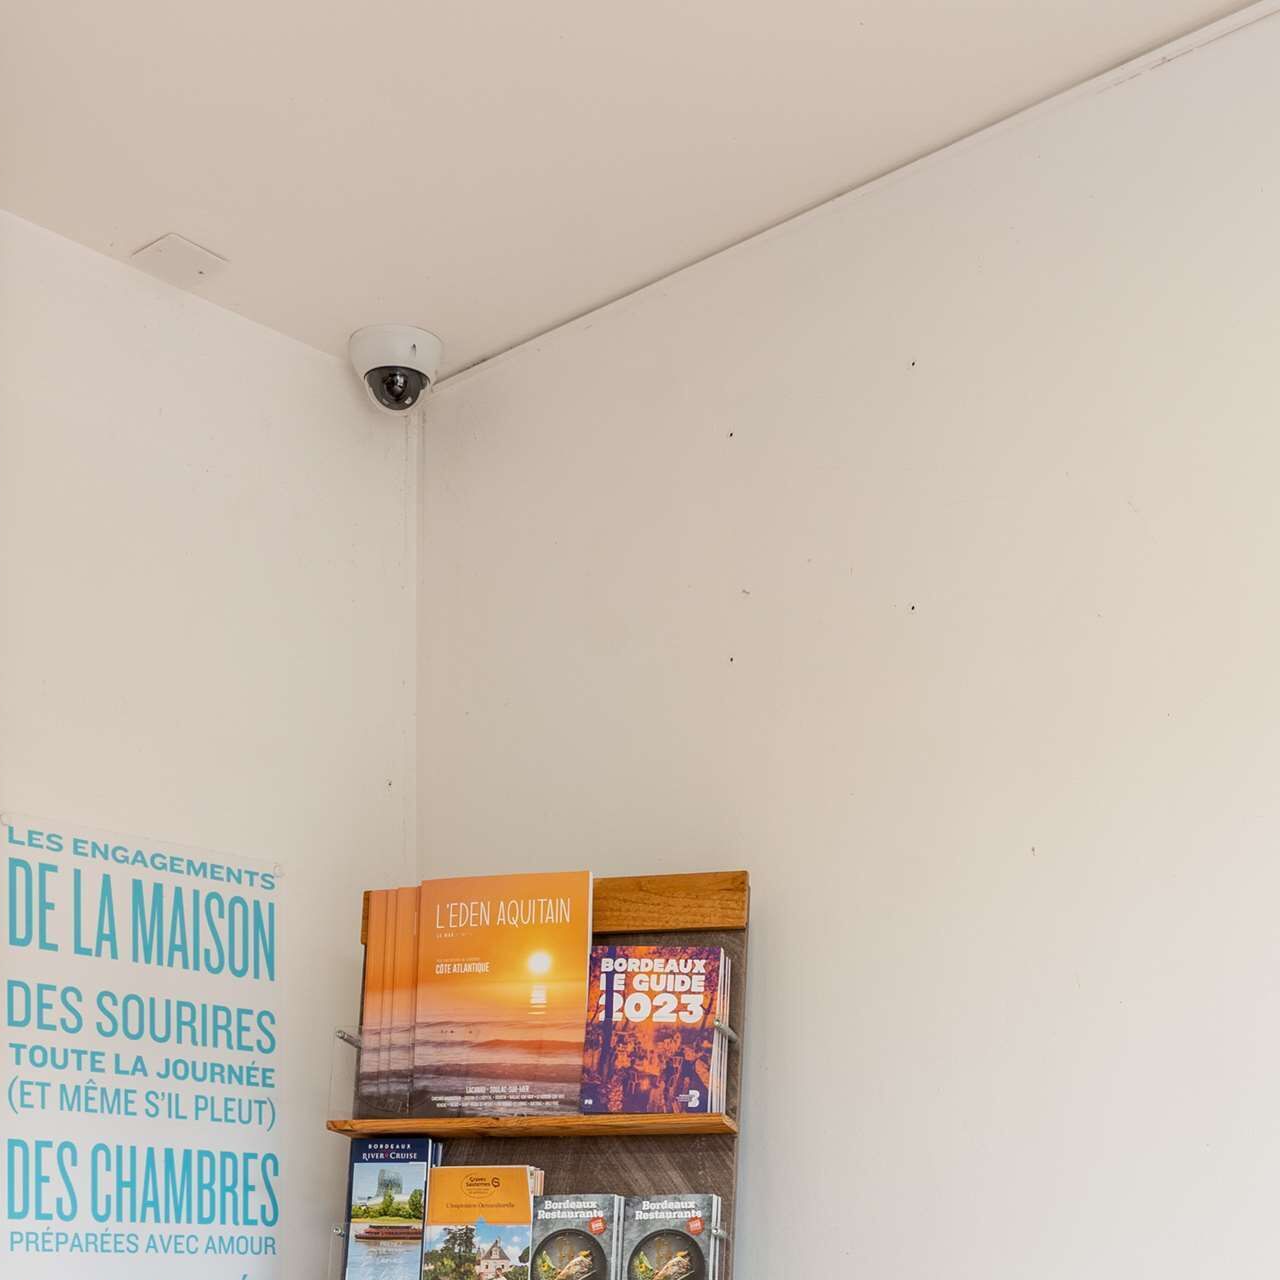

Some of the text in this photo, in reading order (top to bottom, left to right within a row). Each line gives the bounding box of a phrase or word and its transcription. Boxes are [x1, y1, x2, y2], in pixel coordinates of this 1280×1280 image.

[7, 825, 275, 890] LES ENGAGEMENTS
[8, 857, 275, 981] DE LA MAISON
[435, 897, 571, 929] L'EDEN AQUITAIN
[601, 958, 706, 973] BORDEAUX
[7, 979, 276, 1054] DES SOURIRES
[8, 1043, 275, 1088] TOUTE LA JOURNÉE
[7, 1138, 279, 1227] DES CHAMBRES
[537, 1210, 604, 1220] Restaurants
[544, 1200, 597, 1210] Bordeaux
[635, 1210, 701, 1220] Restaurants
[642, 1200, 695, 1210] Bordeaux
[9, 1226, 277, 1255] PRÉPARÉES AVEC AMOUR
